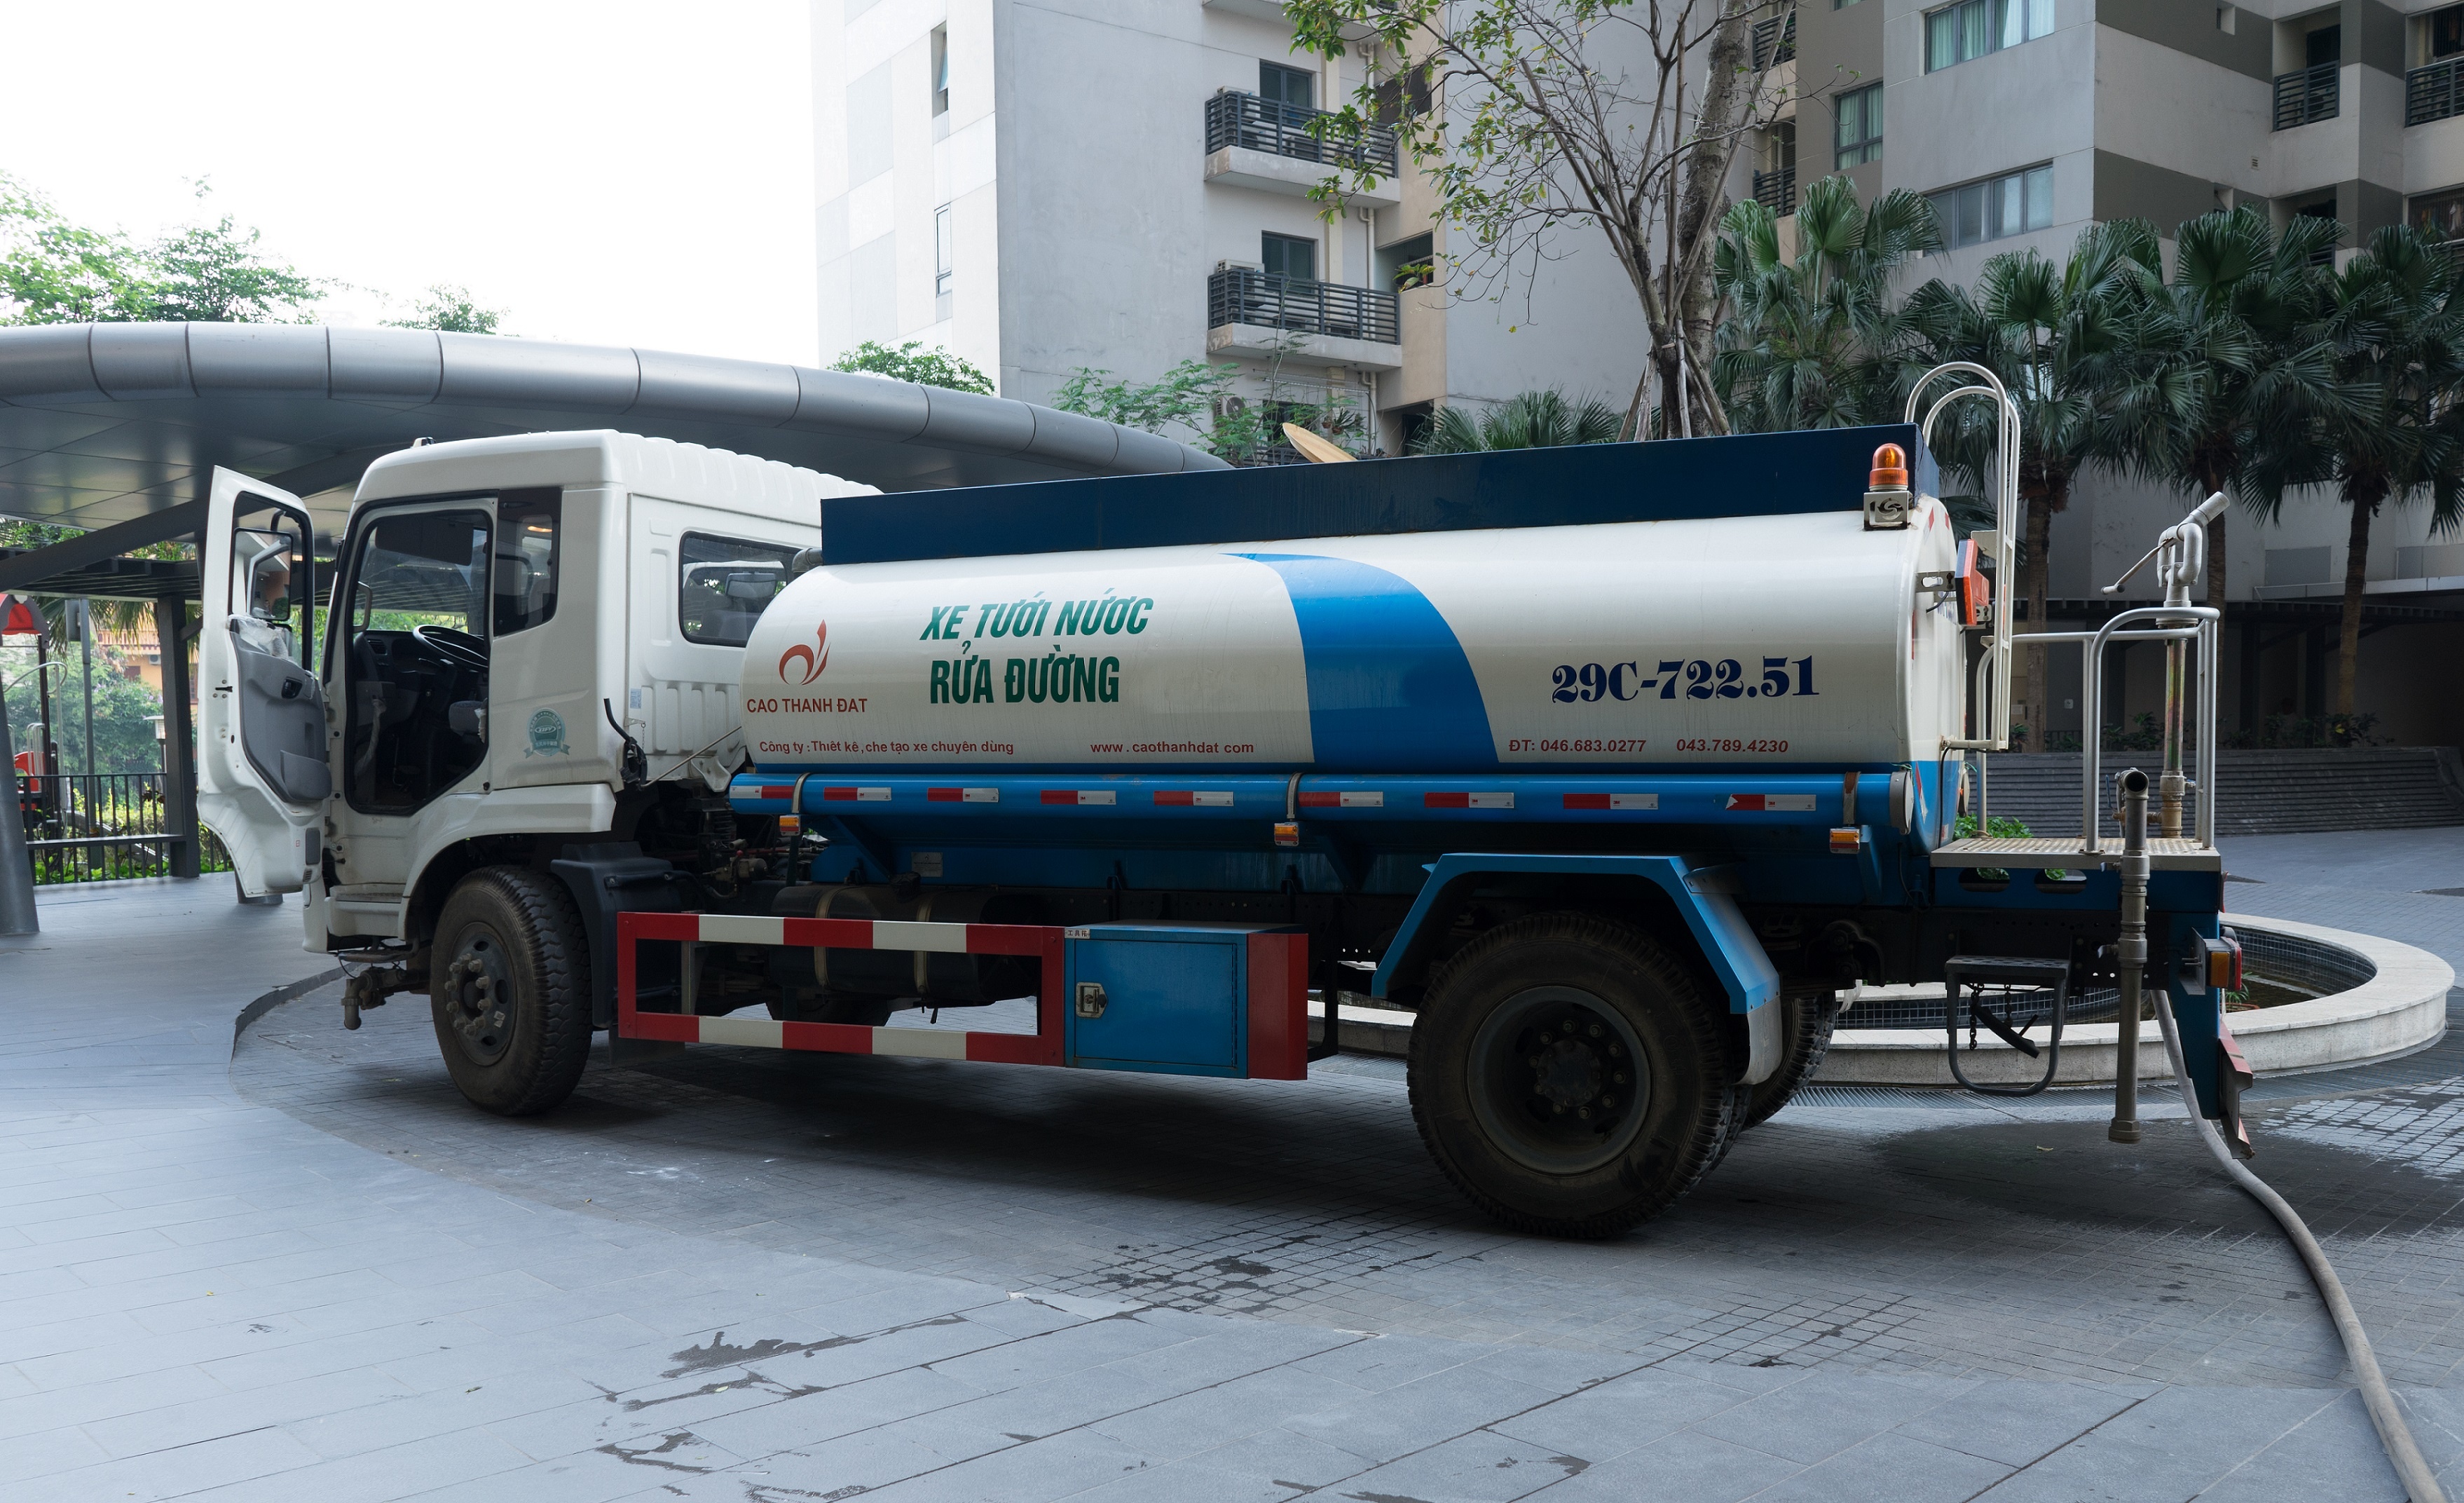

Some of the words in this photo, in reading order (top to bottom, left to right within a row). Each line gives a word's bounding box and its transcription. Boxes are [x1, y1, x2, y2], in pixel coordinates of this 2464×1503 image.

[919, 605, 971, 641] XE
[973, 591, 1053, 639] TƯỚI
[1053, 587, 1154, 637] NƯỚC
[930, 640, 994, 704] RỬA
[1004, 644, 1120, 703] ĐƯỜNG
[1552, 655, 1820, 703] 29C-722.51
[746, 698, 778, 713] CAO
[781, 698, 833, 713] THANH
[759, 741, 790, 754] Công
[890, 741, 910, 755] tạo
[913, 743, 928, 752] xe
[931, 741, 978, 754] chuyên
[981, 740, 1014, 755] dùng
[1508, 740, 1535, 752] ĐT:
[1540, 740, 1647, 752] 046.683.0277
[1676, 739, 1788, 753] 043.789.4230
